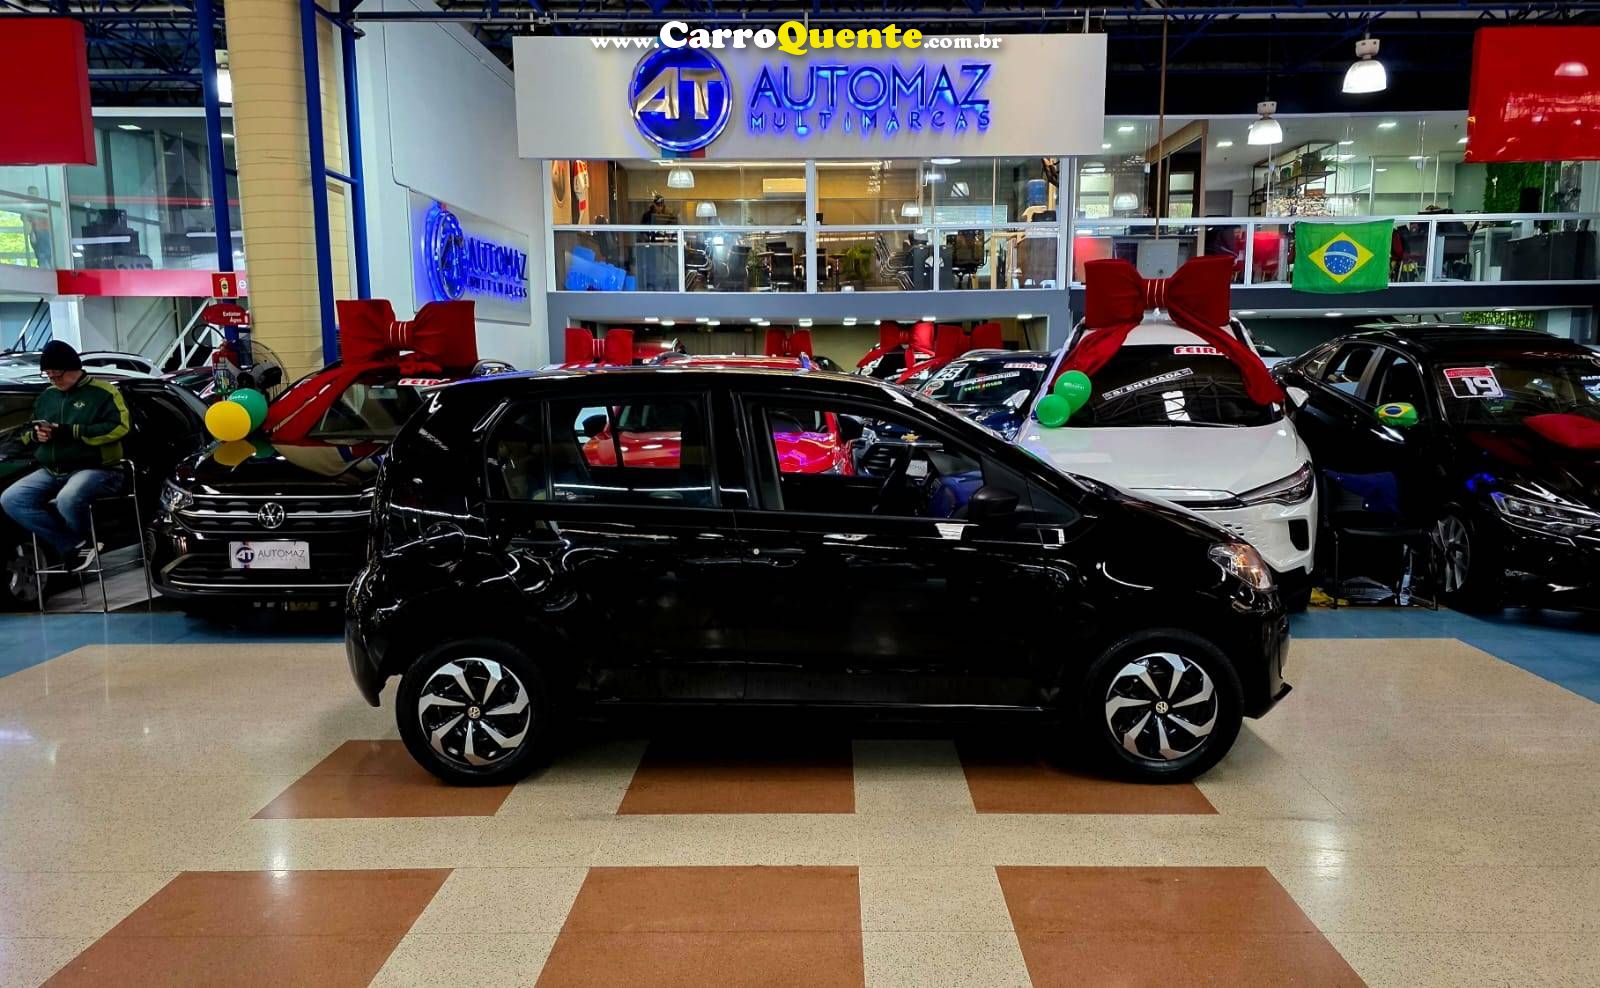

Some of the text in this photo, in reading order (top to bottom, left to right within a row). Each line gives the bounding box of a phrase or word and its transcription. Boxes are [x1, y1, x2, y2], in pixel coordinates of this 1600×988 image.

[750, 64, 991, 110] AUTOMAZ
[751, 110, 990, 130] MULTIMARCAS
[469, 238, 528, 282] AUTOMAZ
[1174, 347, 1221, 355] FEIR
[1461, 377, 1500, 396] 19
[258, 549, 305, 558] AUTOMAZ
